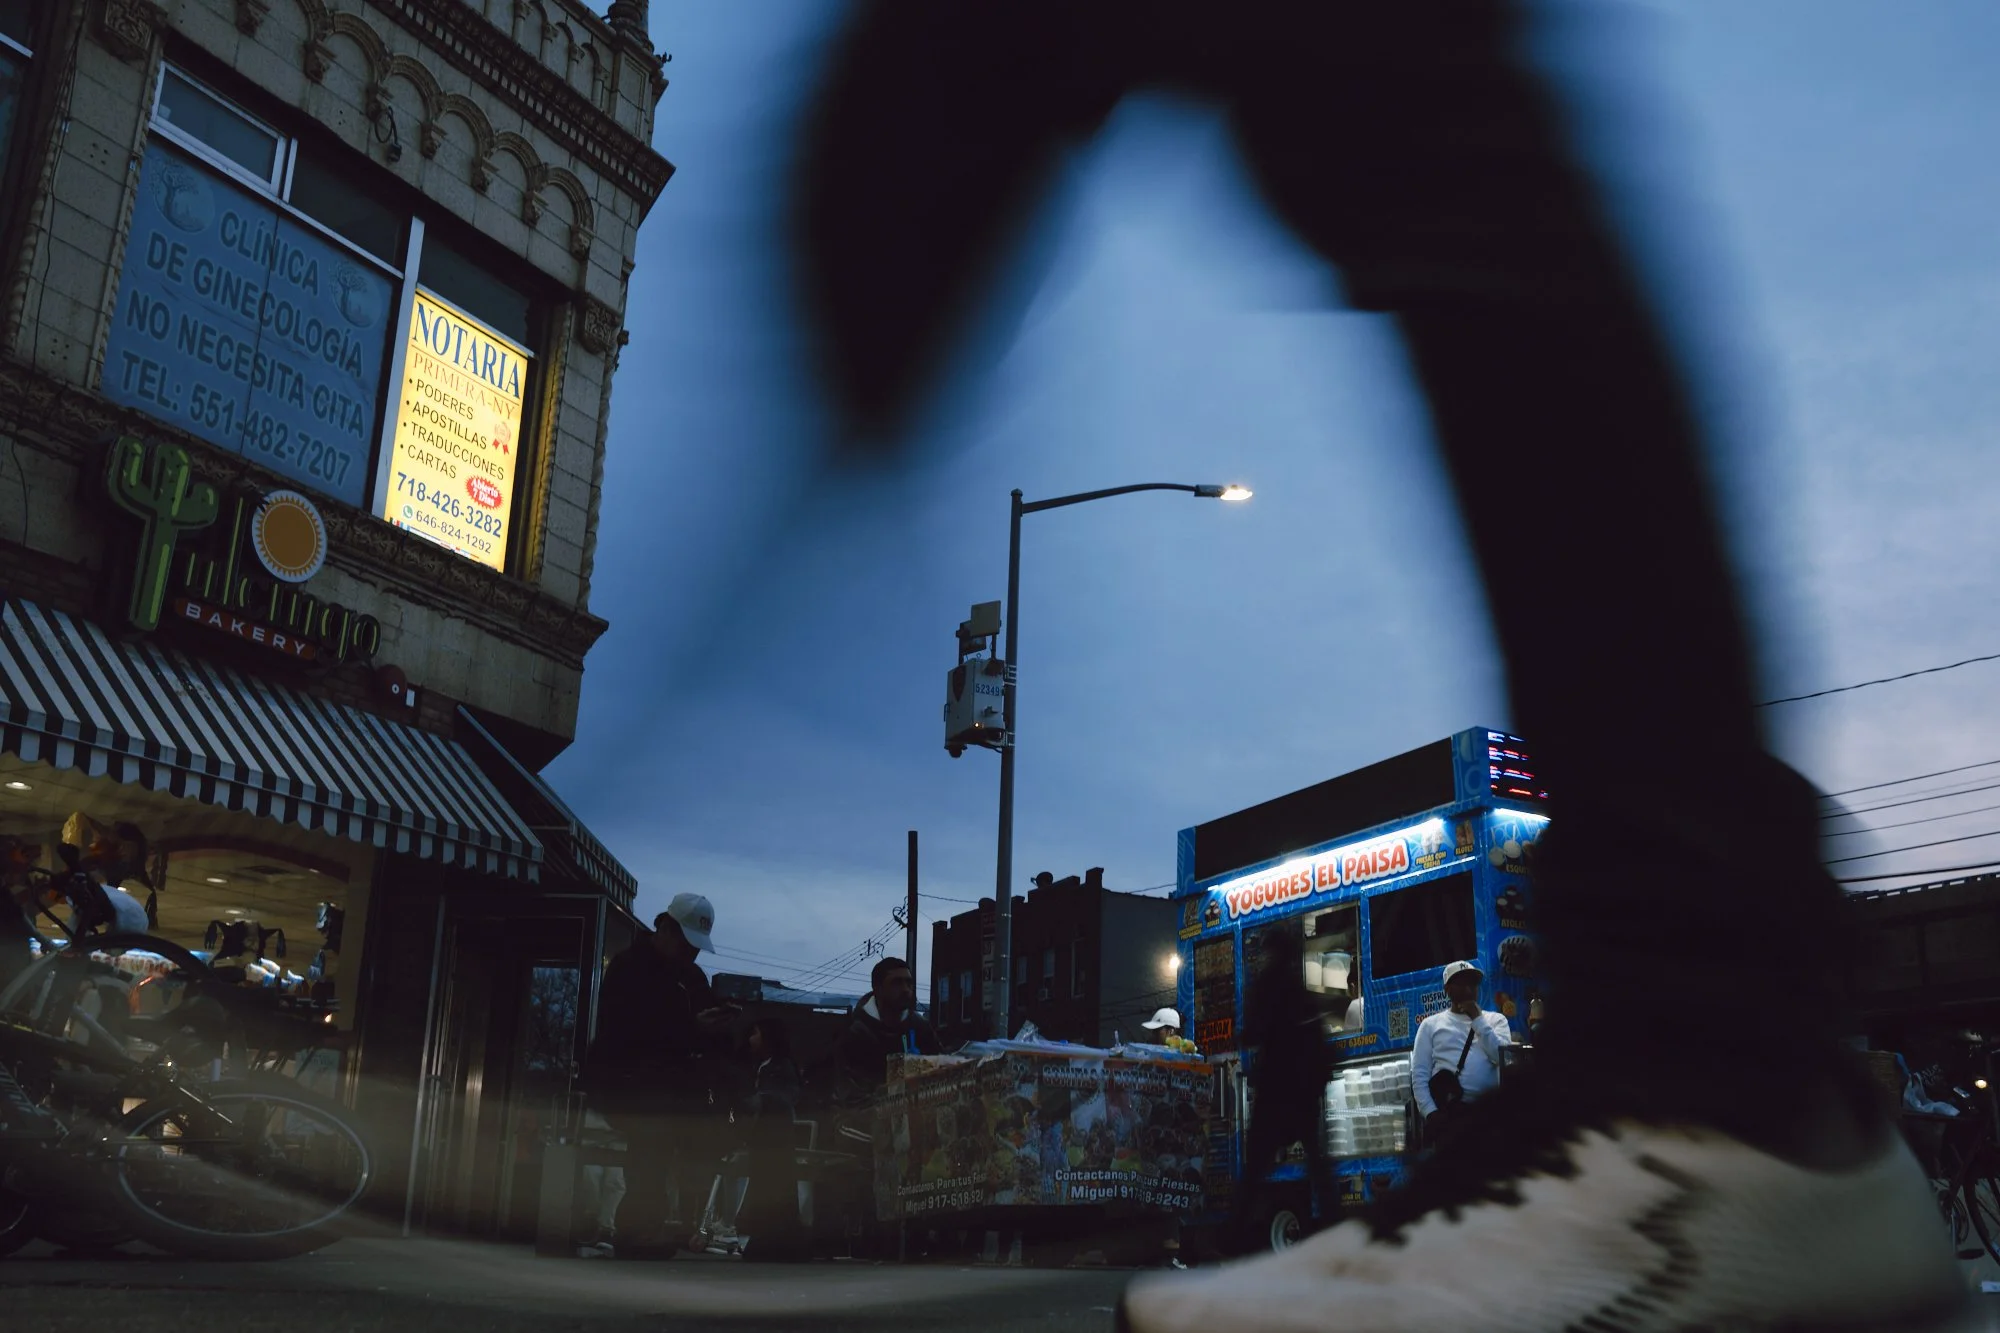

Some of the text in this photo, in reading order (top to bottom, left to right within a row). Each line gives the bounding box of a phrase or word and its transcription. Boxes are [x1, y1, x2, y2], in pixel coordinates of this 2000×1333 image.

[220, 211, 318, 296] CLÍNICA
[147, 231, 363, 377] DE GINECOLOGÍA
[126, 289, 364, 438] NO NECESITA CITA
[412, 301, 520, 399] NOTARIA
[413, 352, 516, 420] PRIMERA-NY
[416, 378, 474, 420] PODERES
[122, 350, 351, 486] TEL: 551-482-7207
[412, 401, 487, 450] APOSTILLAS
[407, 444, 457, 479] CARTAS
[411, 421, 504, 480] TRADUCCIONES
[397, 472, 502, 538] 718-426-3282
[471, 478, 499, 498] Abierto
[473, 487, 479, 498] 7
[416, 510, 492, 554] 646-824-1292
[185, 602, 307, 656] BAKERY
[1228, 844, 1407, 915] YOGURES EL PAISA
[928, 1190, 984, 1210] 917-618-92
[937, 1177, 957, 1190] Para
[958, 1175, 972, 1187] tus
[1055, 1169, 1128, 1181] Contactanos
[1161, 1176, 1200, 1194] Fiestas
[1070, 1184, 1117, 1201] Miguel
